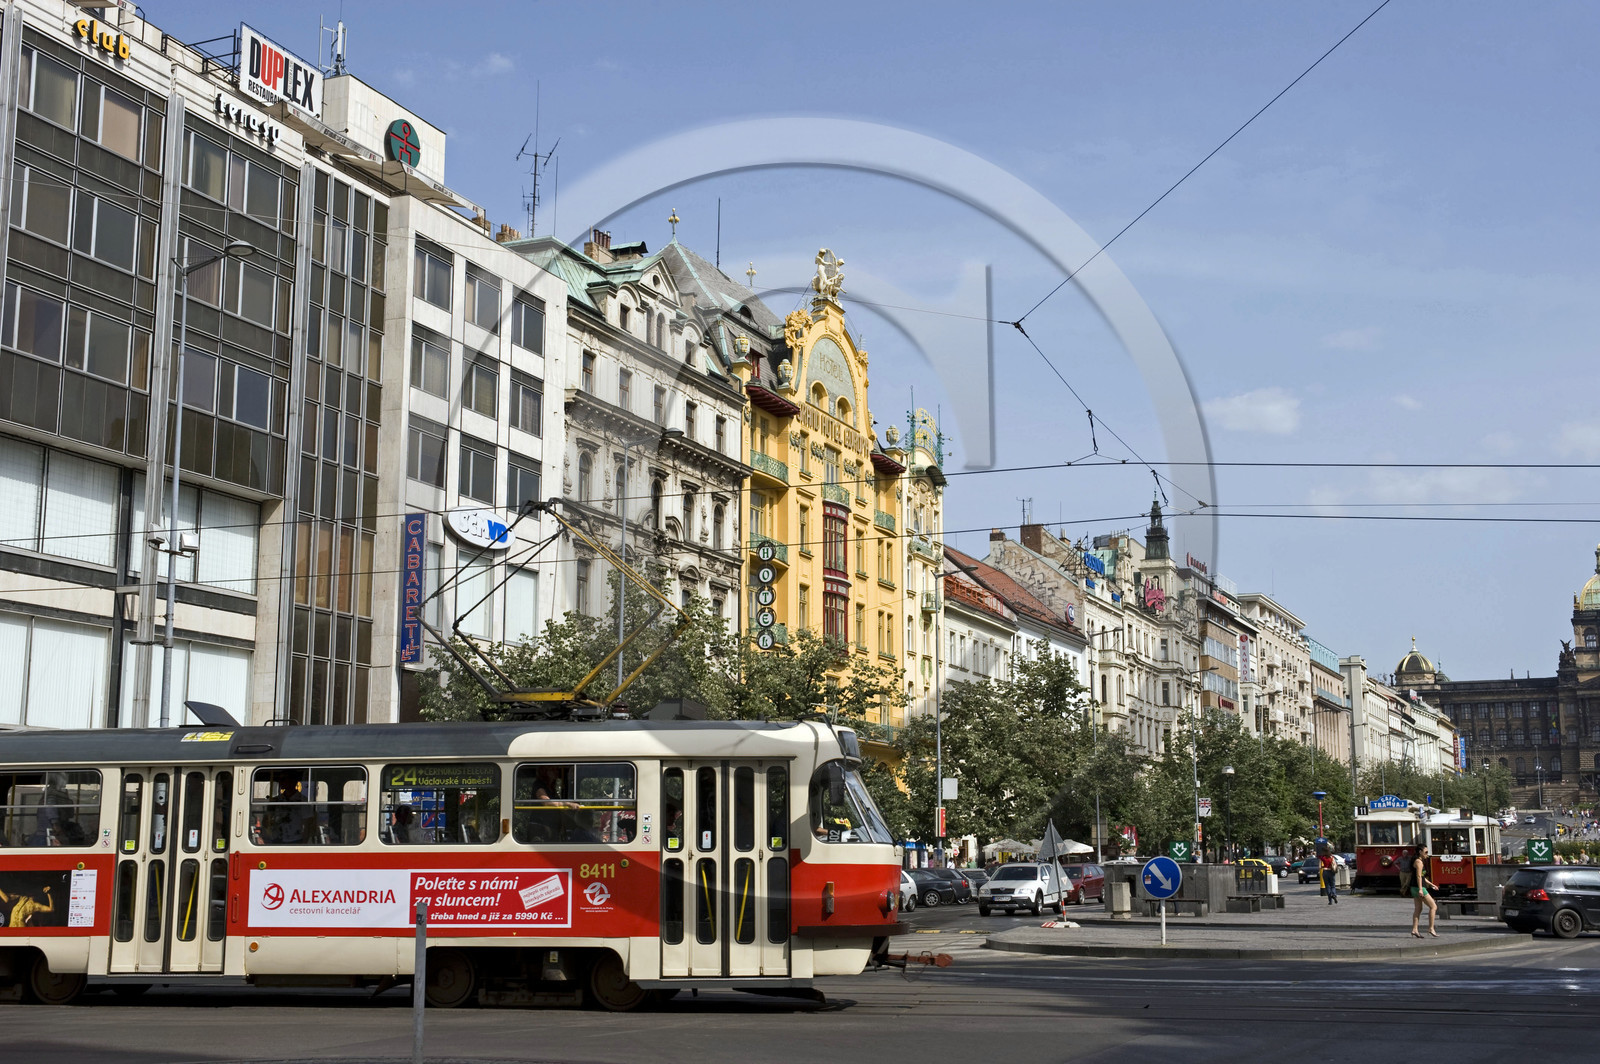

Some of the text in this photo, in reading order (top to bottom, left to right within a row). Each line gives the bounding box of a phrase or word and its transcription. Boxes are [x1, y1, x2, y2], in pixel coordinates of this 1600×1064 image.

[75, 19, 130, 60] club
[248, 35, 315, 113] DUPLEX
[247, 79, 283, 106] RESTAURAN
[404, 519, 422, 639] CABARET
[391, 767, 417, 786] 24
[418, 776, 459, 785] Václavské
[1359, 807, 1367, 815] 11
[1373, 801, 1405, 809] TRAMVAJ
[579, 863, 615, 879] 8411
[1441, 866, 1463, 875] 1429
[414, 876, 519, 891] Poleťte s námi
[289, 888, 397, 904] ALEXANDRIA
[413, 892, 502, 907] za sluncem!
[289, 906, 362, 915] cestovní kancelář
[430, 912, 455, 921] třeba
[456, 912, 480, 921] hned
[481, 913, 487, 921] a
[488, 912, 500, 922] již
[501, 913, 513, 921] za
[514, 912, 539, 921] 5990
[540, 911, 553, 921] Kč
